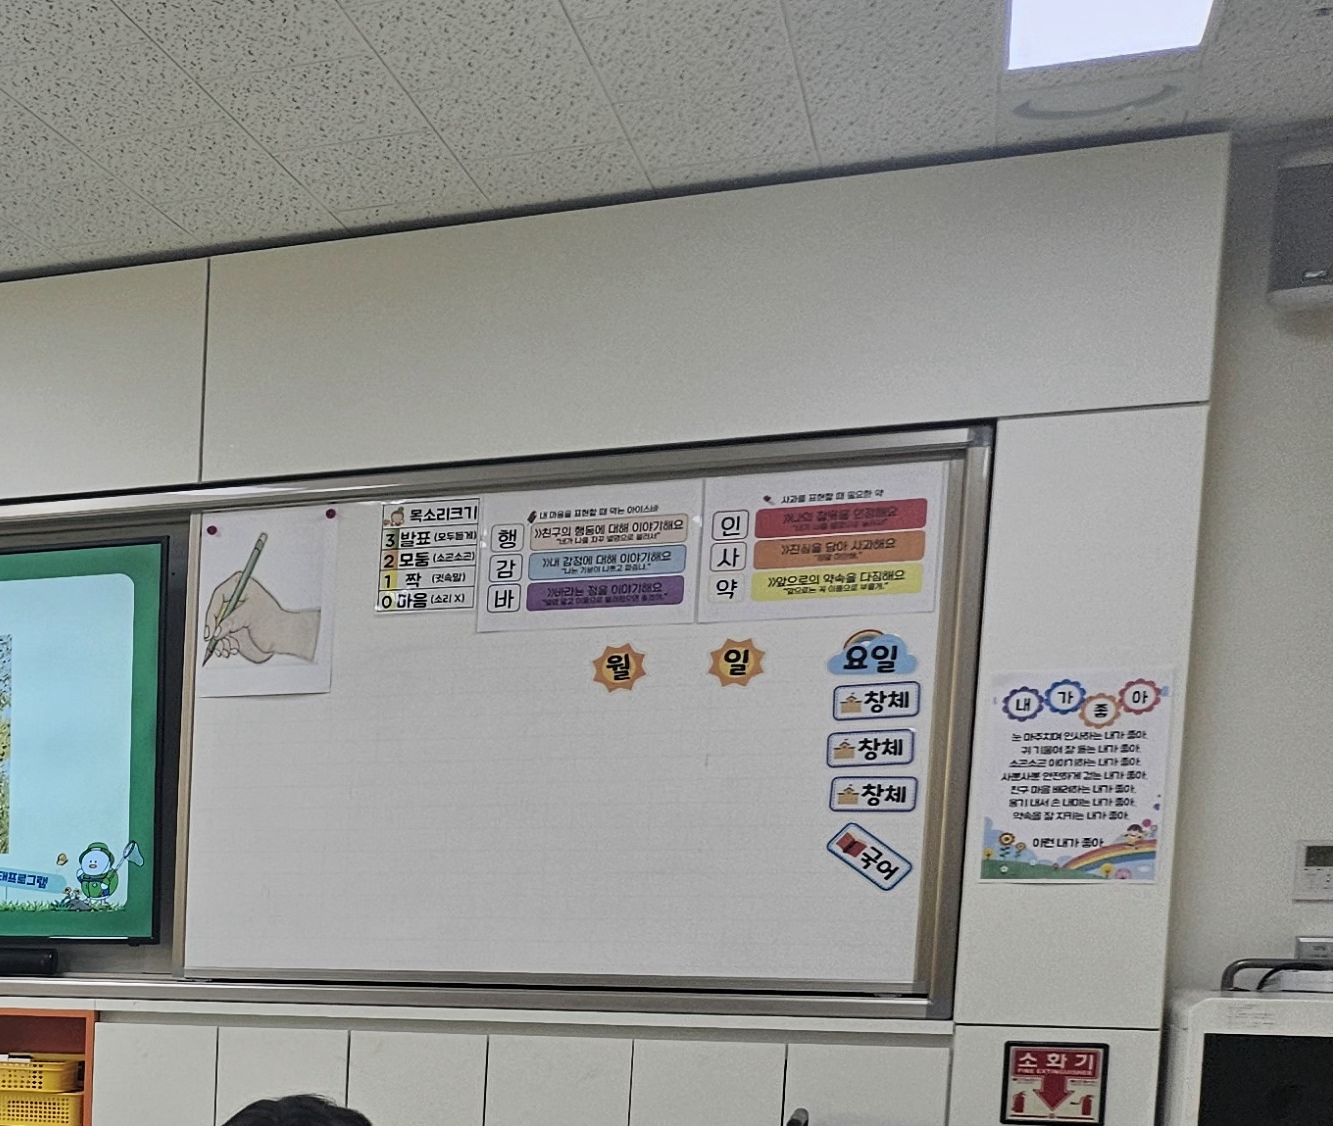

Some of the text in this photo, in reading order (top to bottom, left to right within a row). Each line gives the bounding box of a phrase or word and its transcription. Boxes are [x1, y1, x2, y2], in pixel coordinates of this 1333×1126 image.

[410, 506, 477, 522] 목소리크기
[543, 520, 683, 538] 친구의 행동에 대해 이야기해요
[721, 516, 741, 537] 인
[385, 534, 395, 547] 3
[400, 531, 431, 547] 발표
[497, 528, 517, 549] 행
[851, 538, 896, 550] 사과해요
[384, 552, 475, 568] 2 모둠 (소곤소곤)
[563, 556, 593, 567] 감정에
[596, 554, 616, 565] 대해
[620, 551, 671, 563] 이야기해요
[717, 548, 739, 568] 사
[496, 560, 516, 579] 감
[777, 570, 905, 587] 앞으로의 약속을 다짐해요
[385, 575, 391, 588] 1
[405, 573, 421, 587] 짝
[611, 582, 662, 594] 이야기해요
[716, 578, 737, 599] 약
[382, 593, 465, 608] 0 마음 (소리 X)
[494, 590, 514, 608] 바
[606, 654, 631, 681] 월
[724, 648, 749, 676] 일
[843, 644, 898, 673] 요일
[863, 691, 910, 713] 창체
[857, 738, 903, 761] 창체
[861, 784, 907, 806] 창체
[1057, 838, 1079, 848] 내가
[861, 846, 899, 881] 국어
[1018, 1052, 1093, 1070] 소화기
